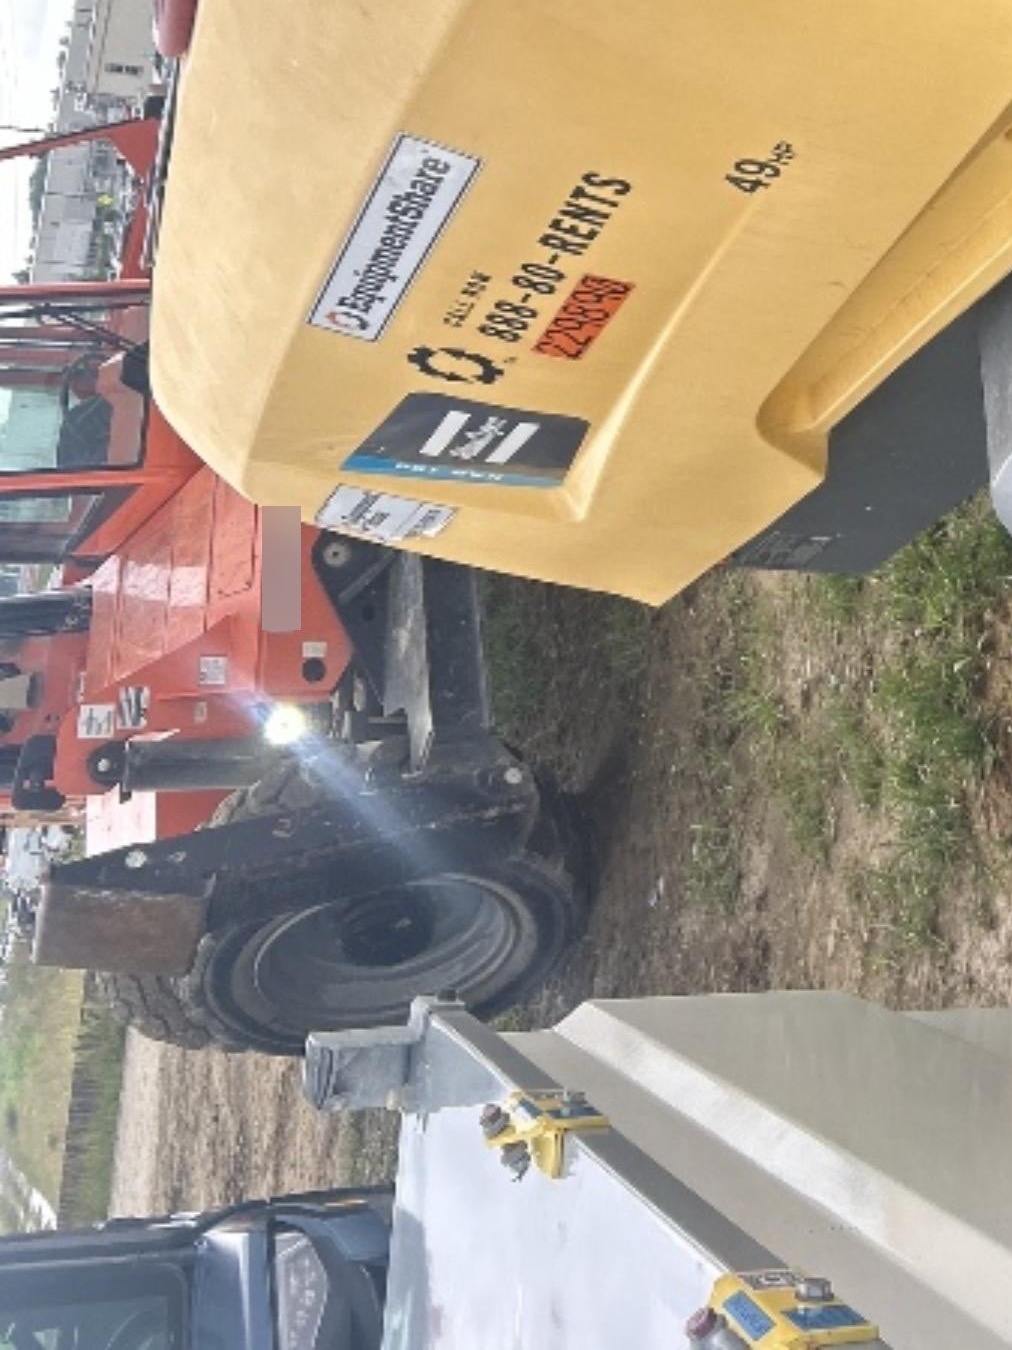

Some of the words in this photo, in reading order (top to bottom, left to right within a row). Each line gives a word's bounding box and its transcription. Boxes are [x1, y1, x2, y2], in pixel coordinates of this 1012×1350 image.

[336, 158, 451, 314] EquipmentShare
[475, 170, 633, 343] 888-80-RENTS
[535, 274, 631, 360] 229890
